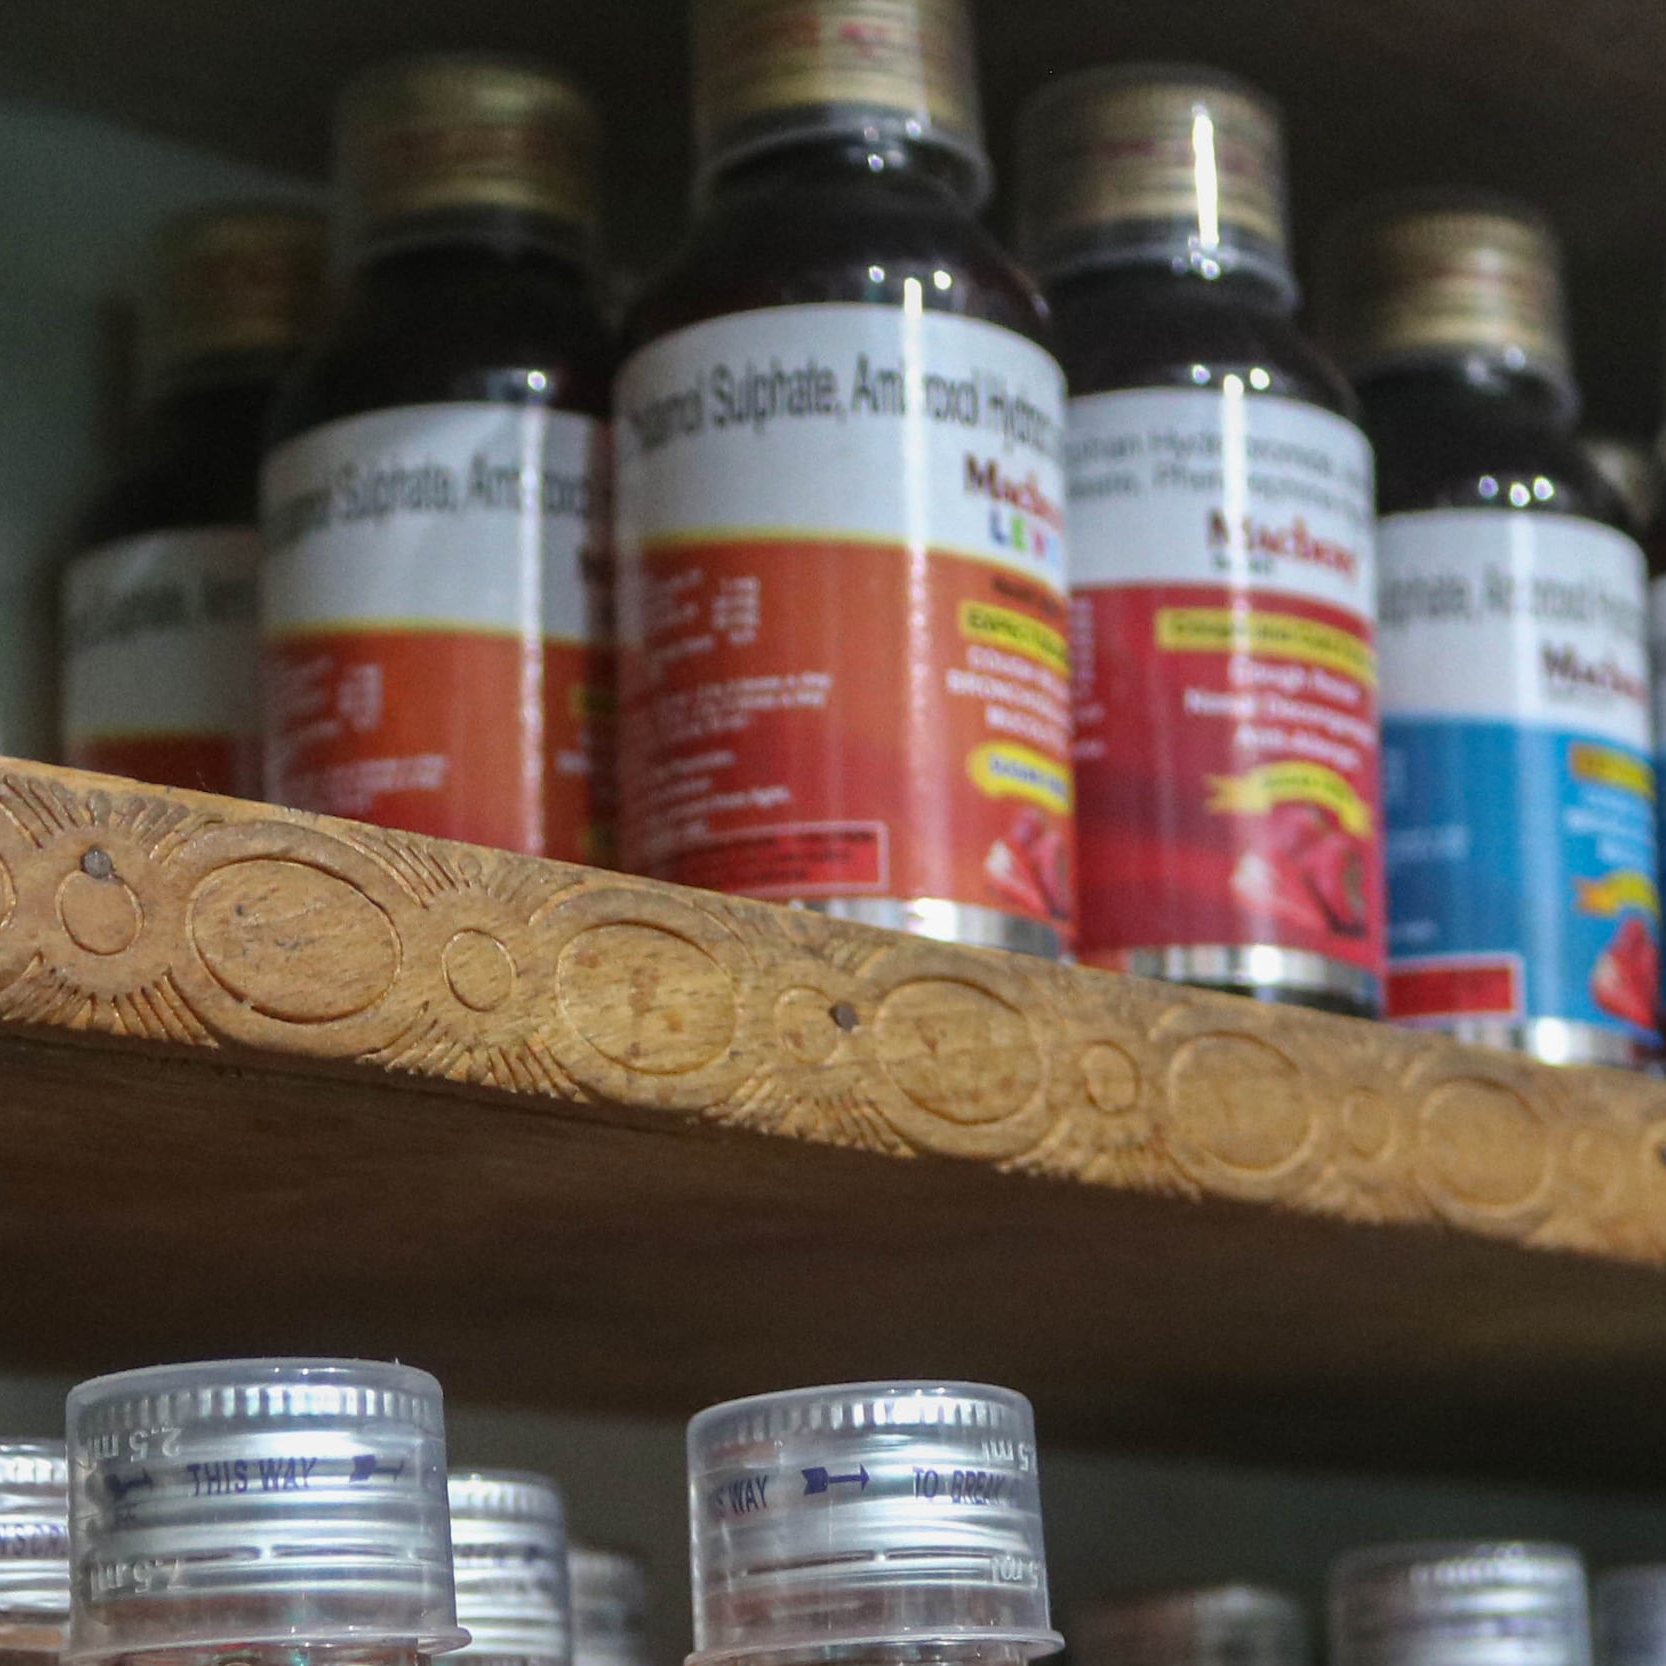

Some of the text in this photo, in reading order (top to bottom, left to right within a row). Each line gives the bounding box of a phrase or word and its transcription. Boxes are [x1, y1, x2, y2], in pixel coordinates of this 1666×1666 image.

[187, 1456, 318, 1497] THIS WAY
[729, 1466, 1006, 1516] WAY TO BREAK
